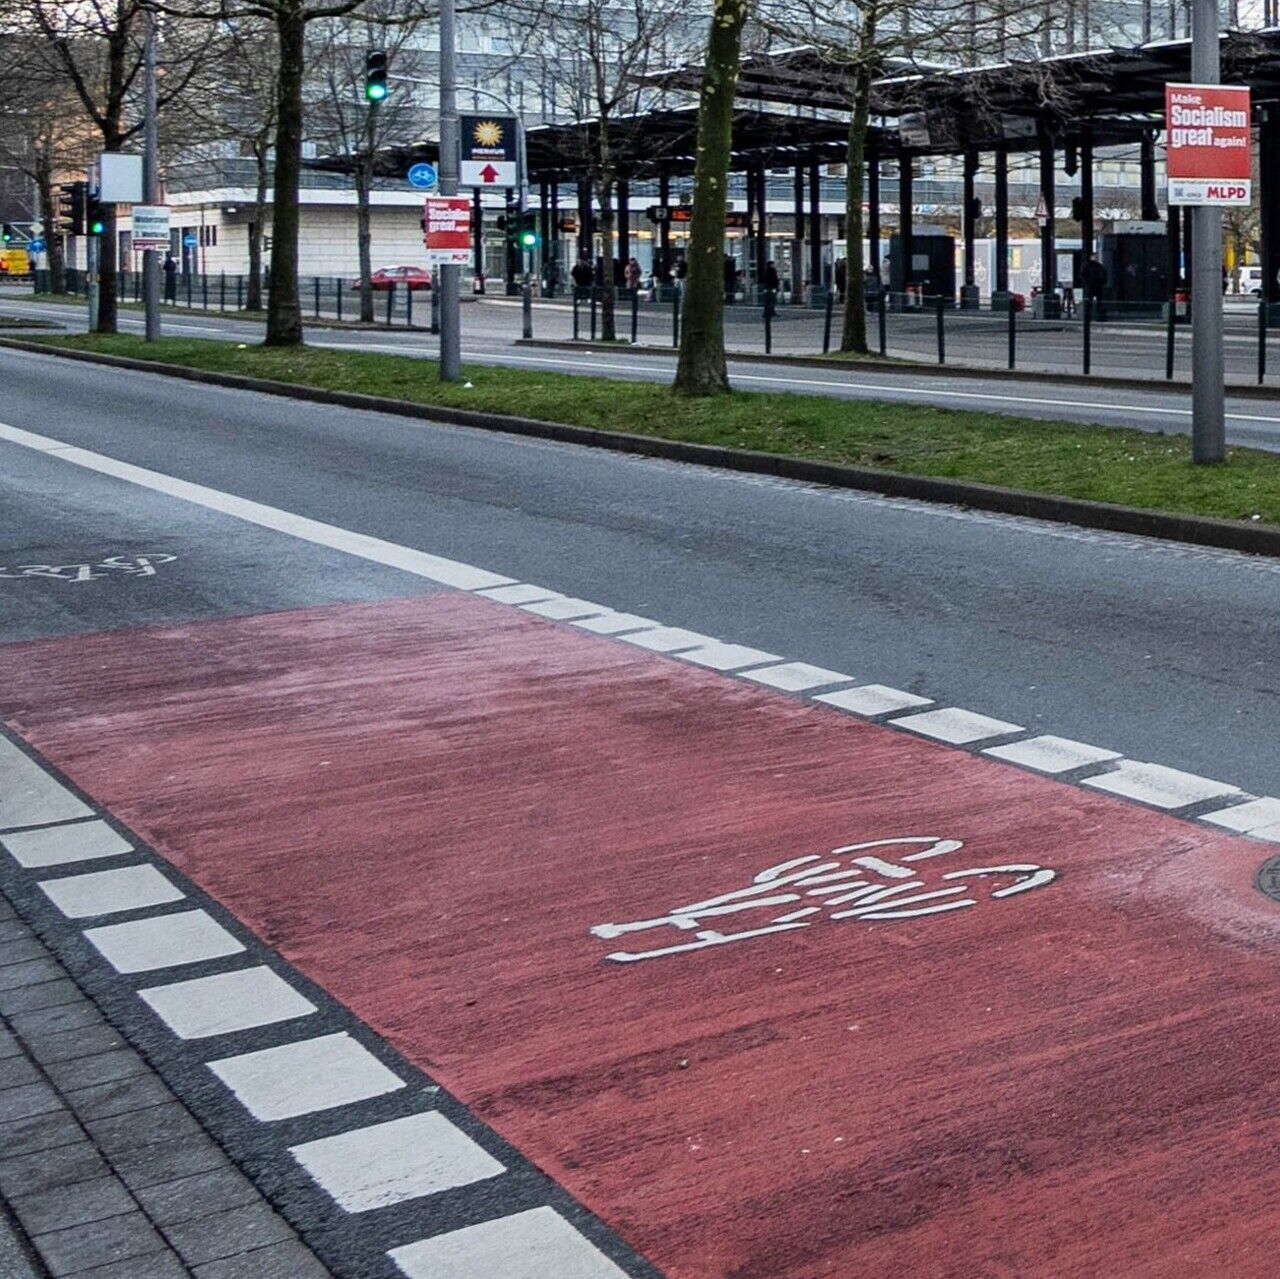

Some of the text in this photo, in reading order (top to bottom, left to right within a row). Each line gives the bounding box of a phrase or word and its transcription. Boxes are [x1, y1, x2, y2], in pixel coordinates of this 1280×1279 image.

[1171, 94, 1202, 105] Make
[1171, 105, 1246, 127] Socialism
[1171, 127, 1246, 148] great again!
[1206, 186, 1246, 199] MLPD
